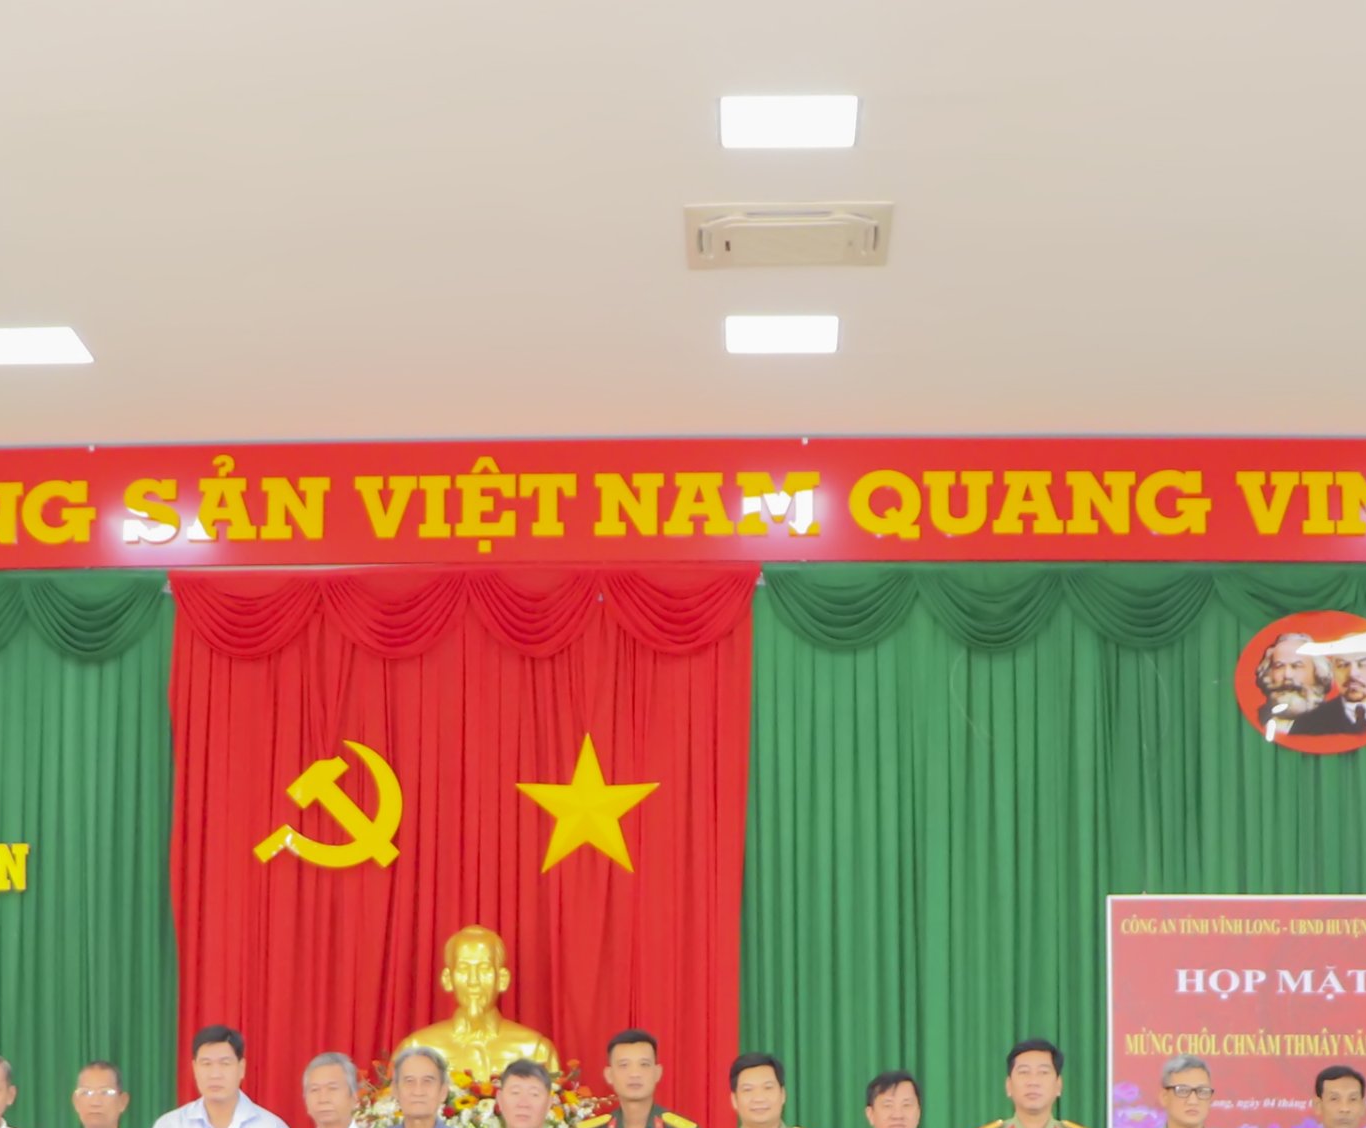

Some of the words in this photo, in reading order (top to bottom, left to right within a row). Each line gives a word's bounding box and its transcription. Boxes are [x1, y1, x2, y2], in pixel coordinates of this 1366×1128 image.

[123, 456, 330, 543] SẢN
[355, 457, 576, 553] VIỆT
[594, 472, 821, 536] NAM
[849, 470, 1211, 540] QUANG
[1121, 914, 1157, 935] CÔNG
[1160, 919, 1176, 934] AN
[1212, 915, 1243, 934] VĨNH
[1246, 918, 1280, 935] LONG
[1291, 918, 1323, 935] UBND
[1175, 968, 1267, 1000] HỌP
[1125, 1028, 1173, 1056] MỪNG
[1176, 1027, 1220, 1056] CHÔL
[1223, 1029, 1281, 1056] CHNĂM
[1284, 1028, 1341, 1056] THMÂY
